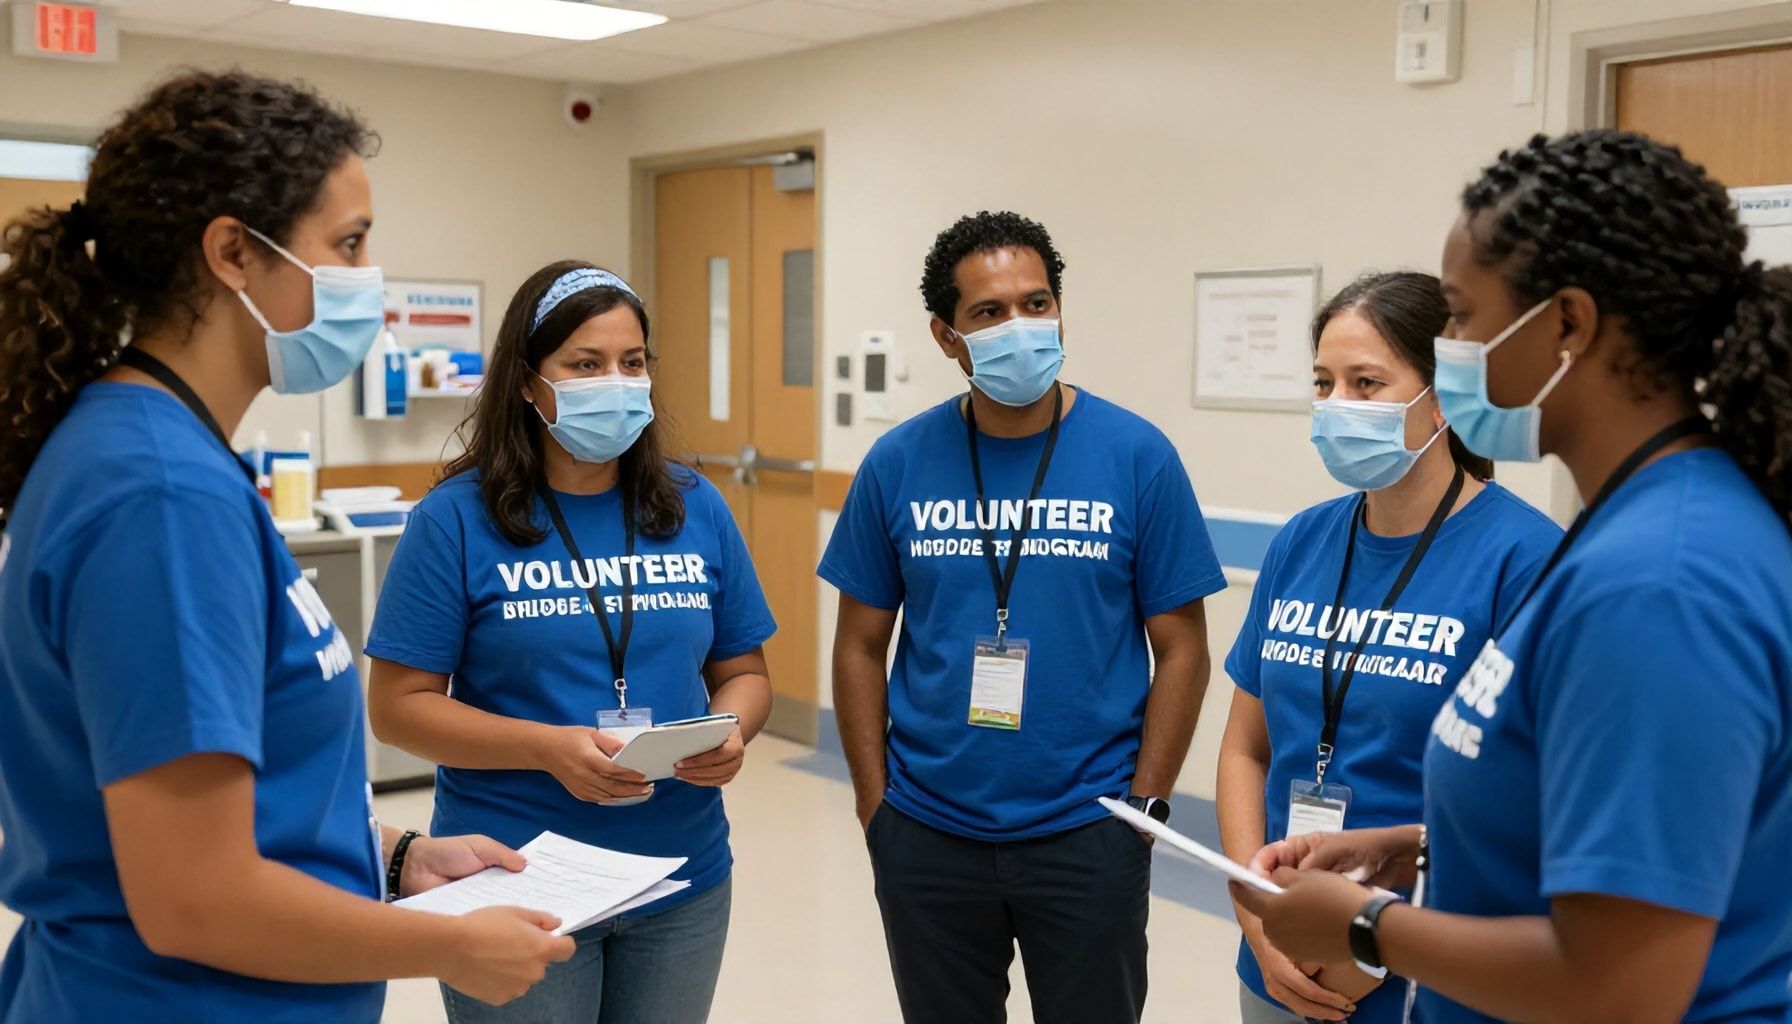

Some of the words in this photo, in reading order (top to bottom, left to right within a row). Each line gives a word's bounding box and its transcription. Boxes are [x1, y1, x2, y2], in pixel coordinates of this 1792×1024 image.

[909, 499, 1114, 534] VOLUNTEER
[497, 553, 708, 592] VOLUNTEER
[1267, 598, 1465, 657] VOLUNTEER
